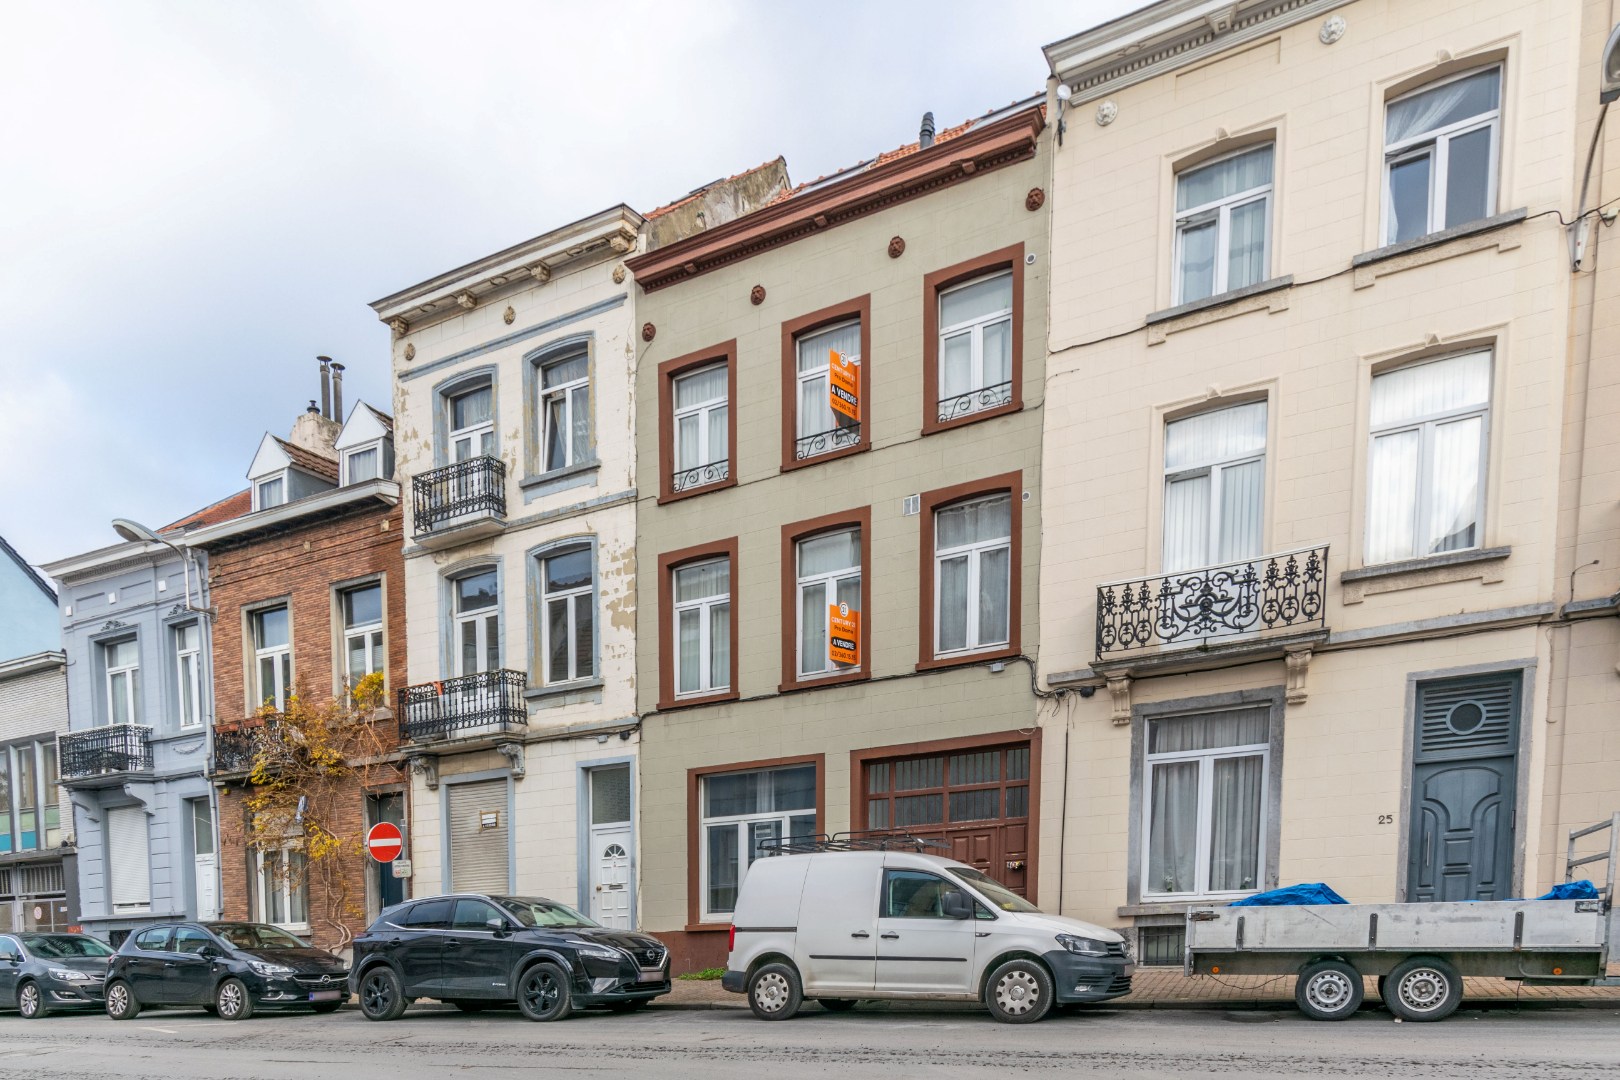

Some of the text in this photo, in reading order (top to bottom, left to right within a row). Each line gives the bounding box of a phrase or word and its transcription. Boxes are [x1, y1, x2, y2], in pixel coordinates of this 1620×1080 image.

[831, 363, 851, 379] CENTURY
[831, 384, 858, 406] A VENDRE
[831, 616, 851, 627] CENTURY
[837, 639, 855, 650] VENDRE
[1378, 814, 1393, 825] 25
